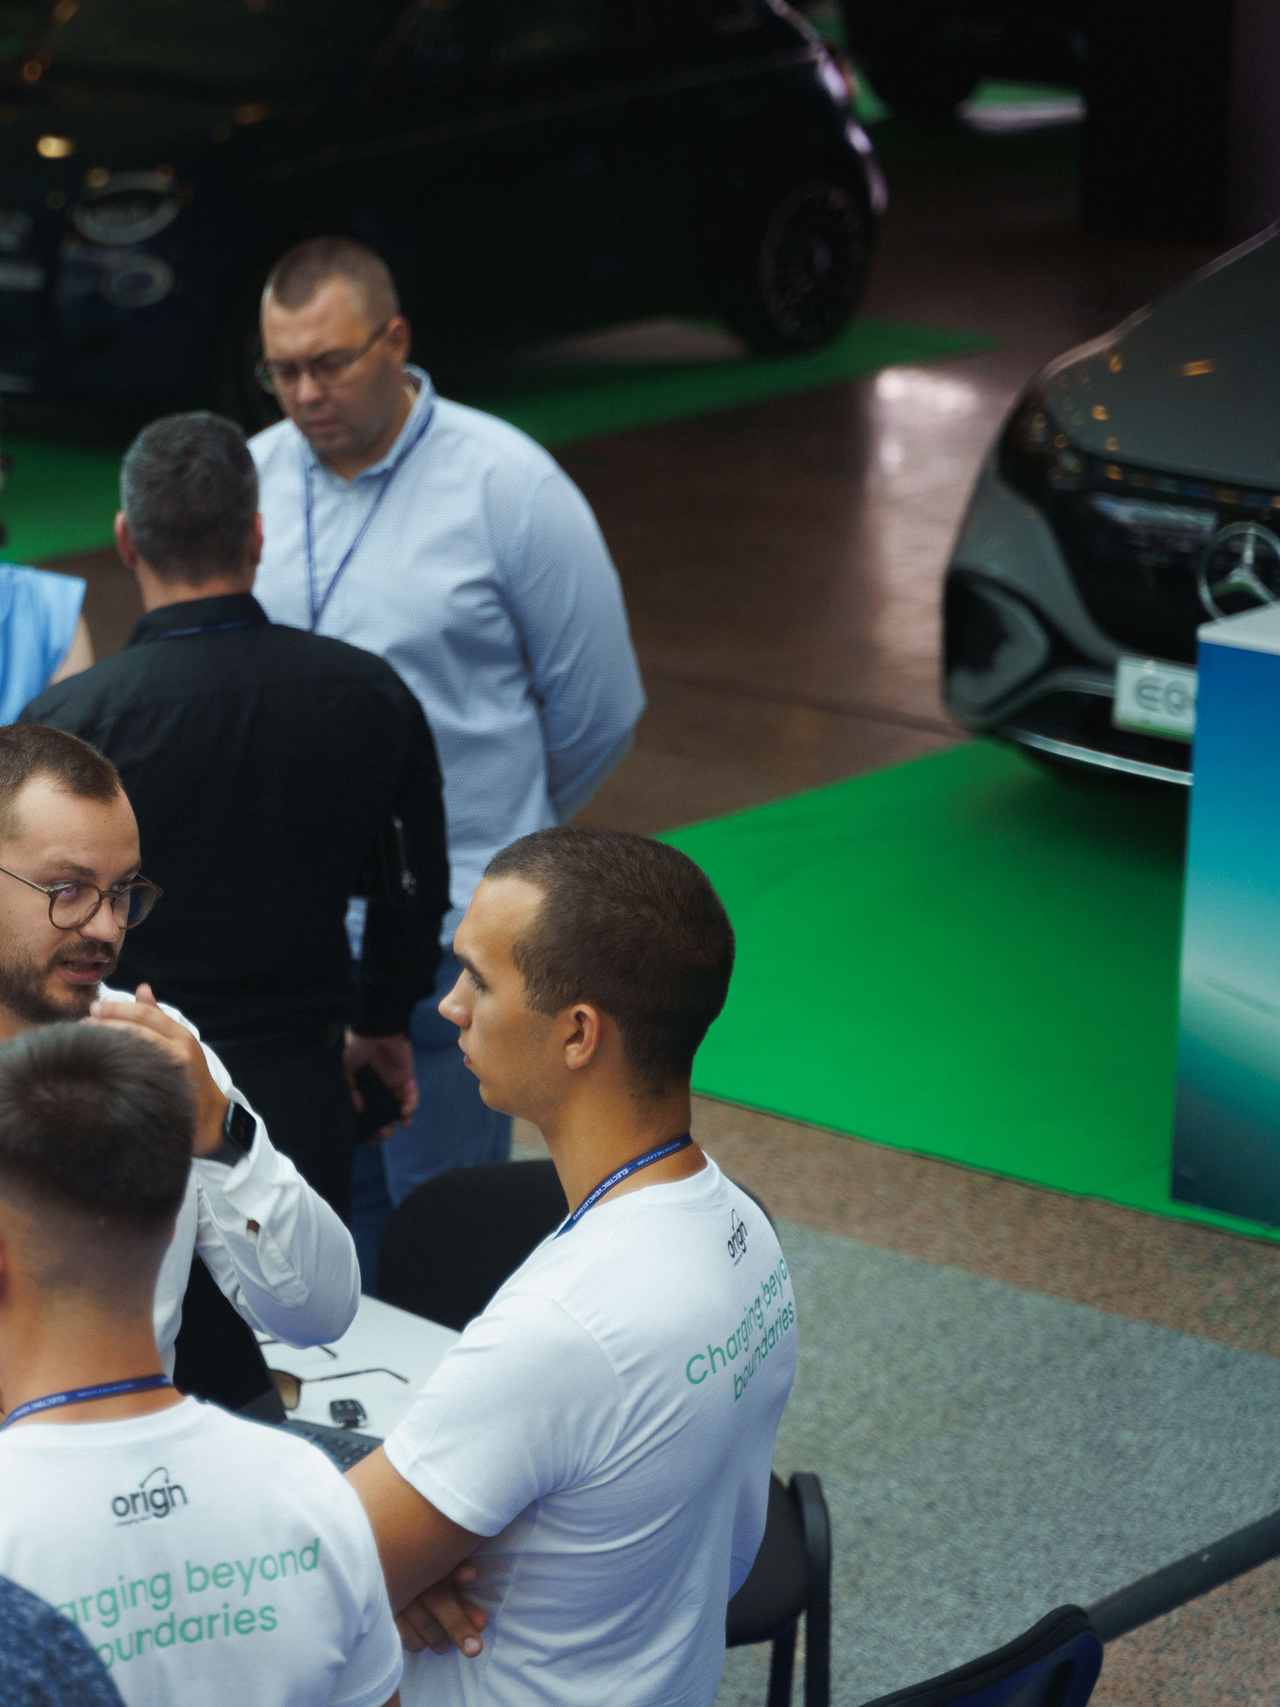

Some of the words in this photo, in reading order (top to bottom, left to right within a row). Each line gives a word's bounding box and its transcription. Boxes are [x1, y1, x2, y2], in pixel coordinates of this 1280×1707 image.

[685, 1295, 764, 1385] Charging
[734, 1301, 794, 1402] boundaries
[56, 1570, 171, 1628] arging
[185, 1537, 321, 1597] beyond
[96, 1602, 278, 1669] oundaries
